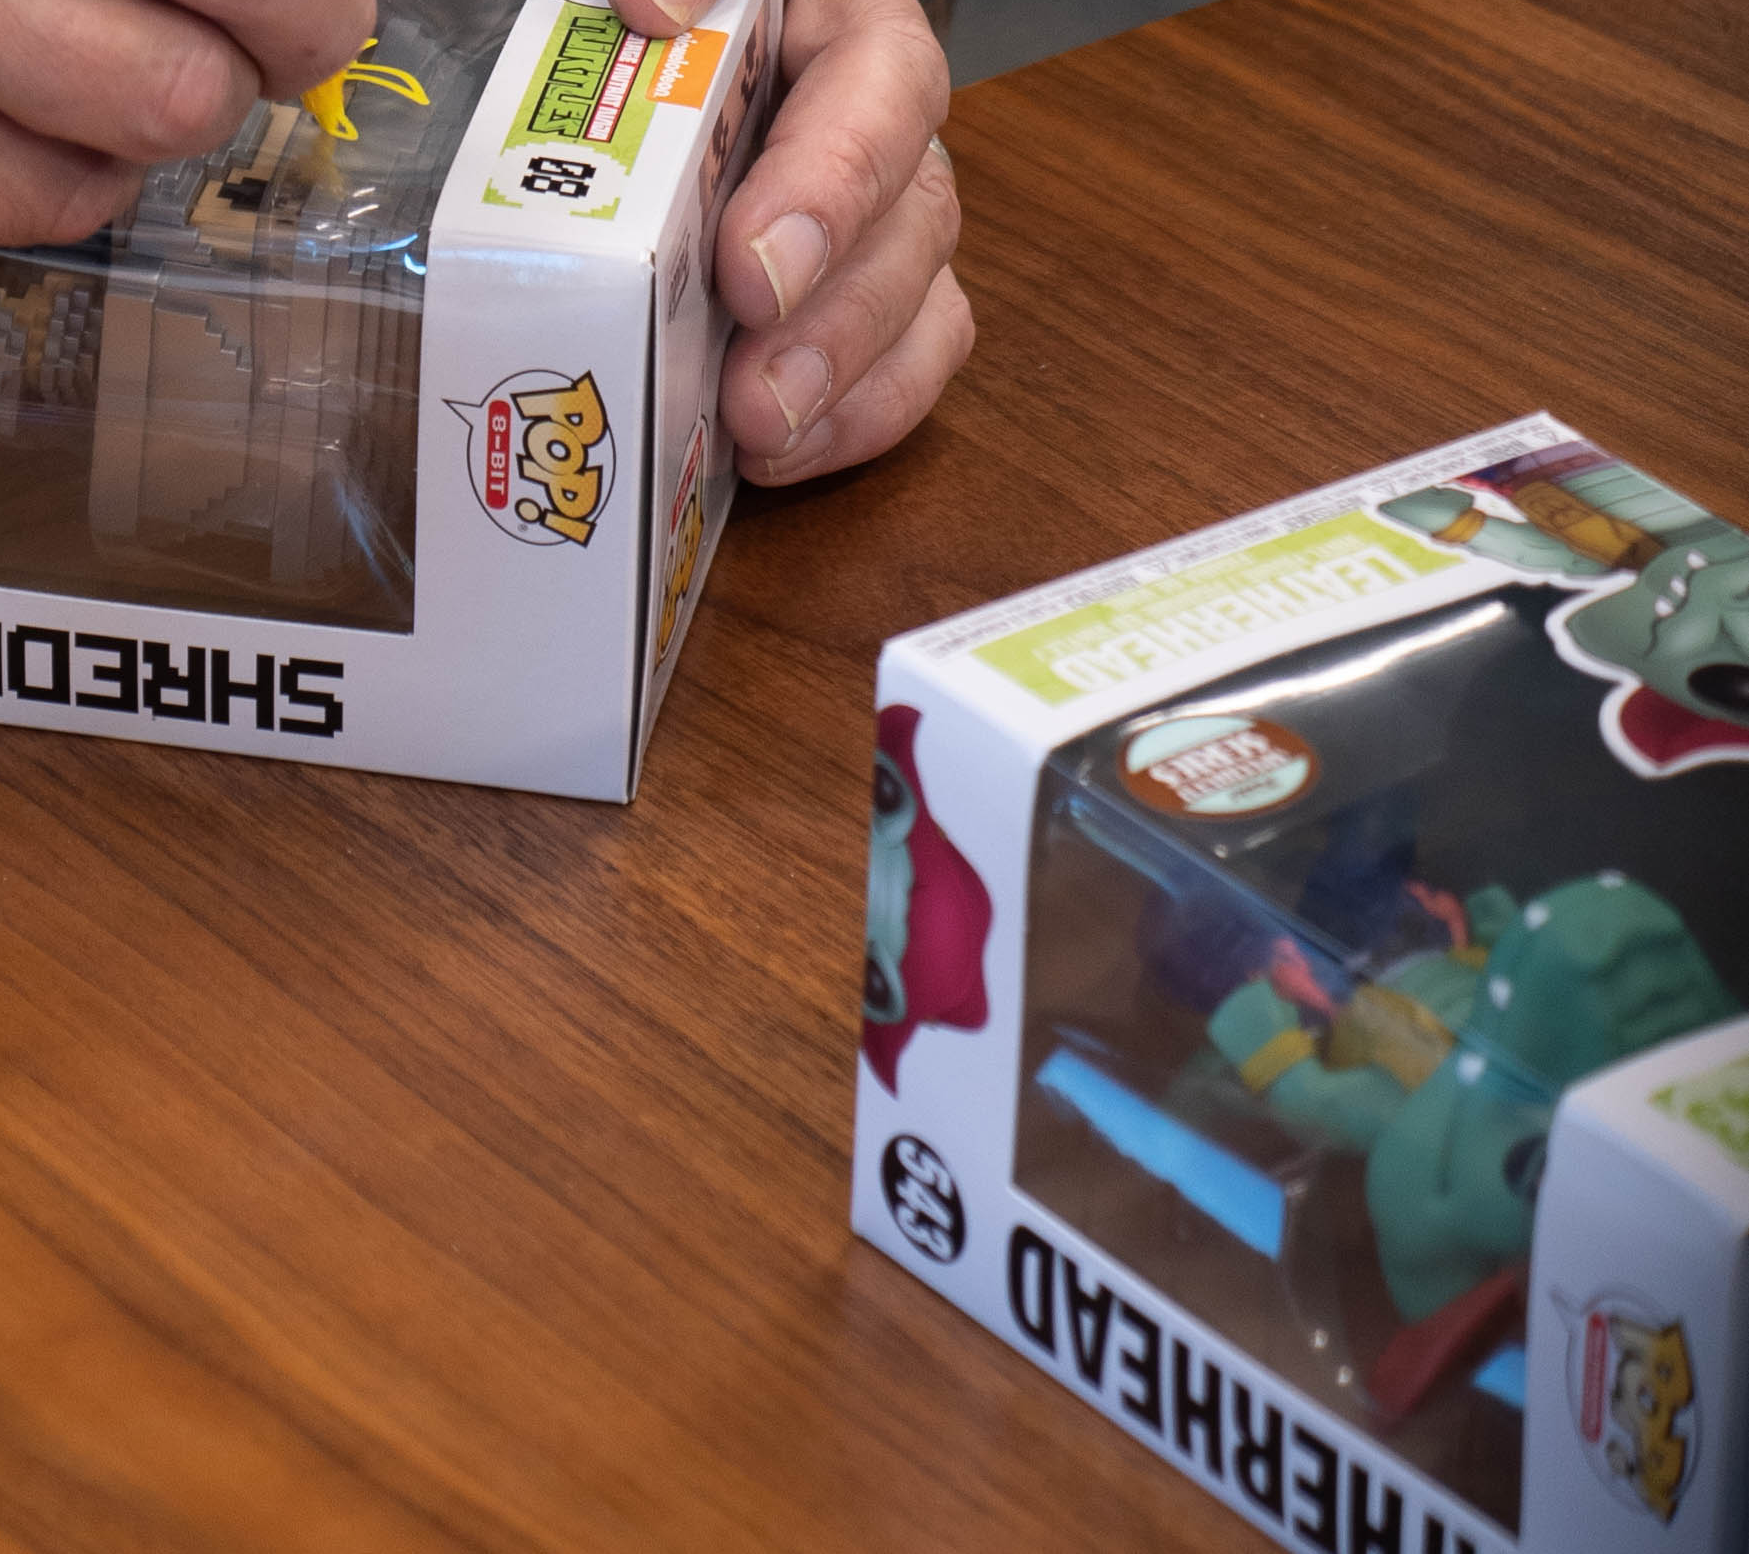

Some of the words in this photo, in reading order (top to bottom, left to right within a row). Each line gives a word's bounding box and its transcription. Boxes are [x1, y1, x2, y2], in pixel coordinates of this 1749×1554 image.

[528, 16, 624, 138] TURTLES
[585, 105, 619, 141] NINJA
[600, 62, 636, 108] MUTANT
[520, 156, 597, 199] 08
[490, 415, 507, 496] 8-BIT
[510, 370, 605, 549] POP!
[1049, 544, 1421, 692] LEATHERHEAD
[894, 1139, 953, 1261] 543
